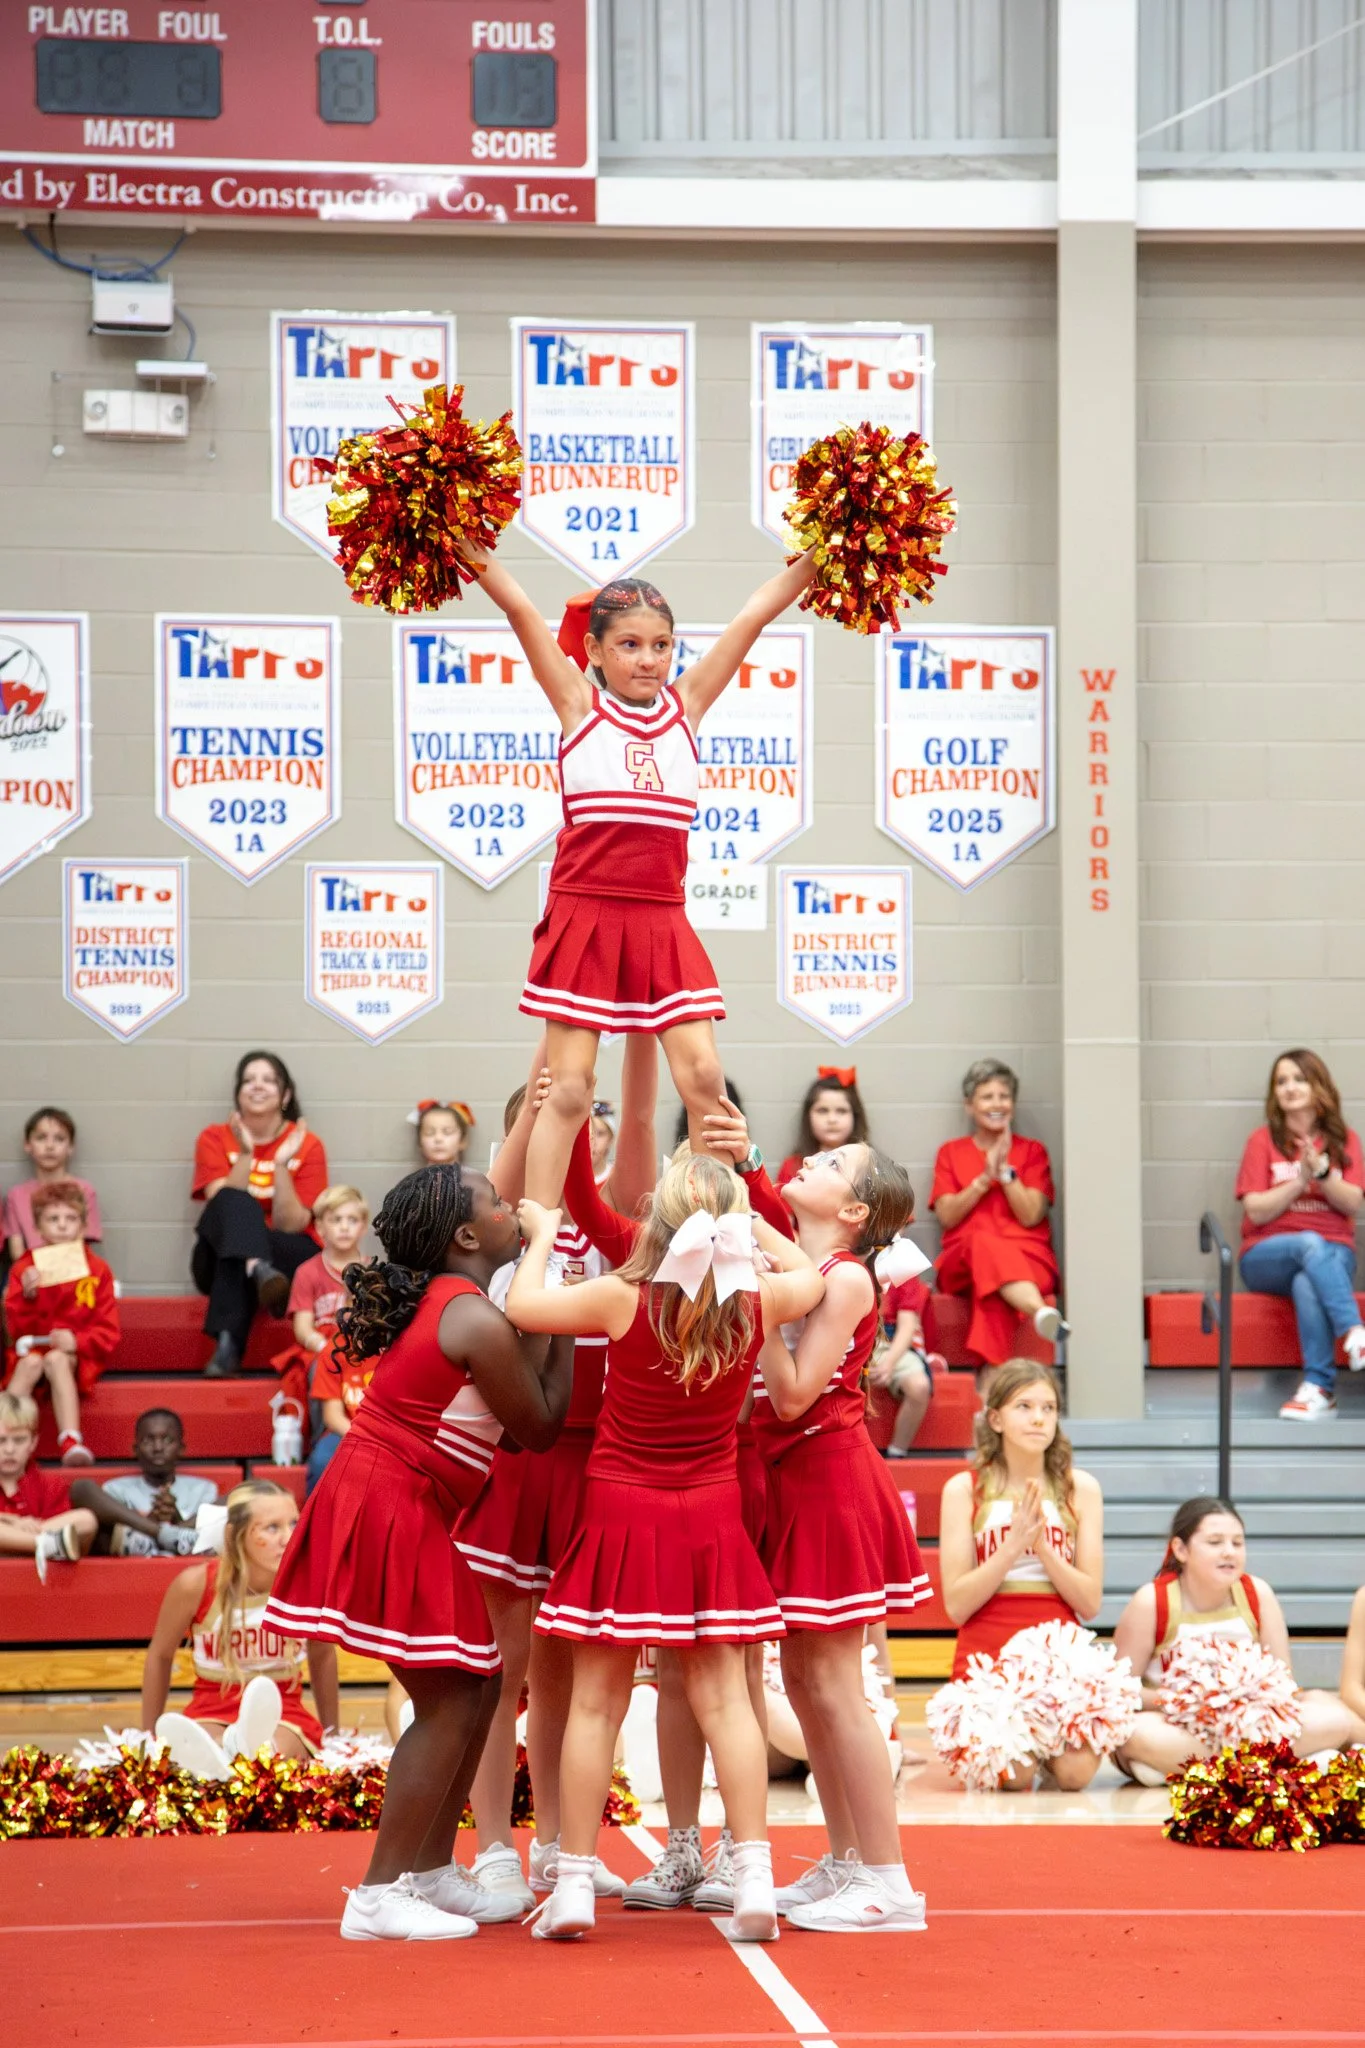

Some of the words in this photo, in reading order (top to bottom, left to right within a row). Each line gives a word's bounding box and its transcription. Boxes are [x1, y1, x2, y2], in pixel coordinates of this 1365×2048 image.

[28, 10, 129, 38] PLAYER
[159, 12, 228, 41] FOUL
[314, 17, 382, 46] T.O.L.
[472, 21, 555, 50] FOULS
[84, 119, 175, 149] MATCH
[472, 131, 556, 160] SCORE
[0, 167, 24, 200] d
[34, 168, 76, 210] by
[84, 172, 200, 206] Electra
[211, 176, 429, 211] Construction
[514, 183, 579, 214] Inc.
[529, 433, 679, 464] BASKETBALL
[529, 464, 679, 496] RUNNERUP
[566, 506, 640, 533] 2021
[592, 541, 621, 560] 1A
[171, 727, 324, 757] TENNIS
[410, 732, 559, 761] VOLLEYBALL
[697, 736, 796, 765] LEYBALL
[924, 737, 1009, 766] GOLF
[172, 758, 324, 790] CHAMPION
[411, 763, 560, 794] CHAMPION
[625, 741, 664, 793] CA
[0, 779, 74, 812] PION
[892, 768, 1042, 800] CHAMPION
[1079, 669, 1117, 912] WARRIORS
[209, 798, 287, 825] 2023
[449, 803, 526, 829] 2023
[690, 807, 760, 832] 2024
[928, 808, 1004, 834] 2025
[236, 833, 265, 852] 1A
[475, 837, 504, 856] 1A
[710, 841, 739, 860] 1A
[953, 842, 981, 862] 1A
[692, 883, 760, 900] GRADE
[720, 901, 732, 917] 2
[75, 926, 175, 945] DISTRICT
[320, 931, 428, 949] REGIONAL
[793, 933, 897, 951] DISTRICT
[75, 948, 175, 967] TENNIS
[320, 952, 367, 970] TRACK
[371, 952, 381, 970] &
[386, 952, 428, 970] FIELD
[792, 953, 897, 972] TENNIS
[75, 969, 175, 990] CHAMPION
[320, 973, 372, 993] THIRD
[376, 973, 428, 994] PLACE
[793, 975, 898, 995] RUNNER-UP
